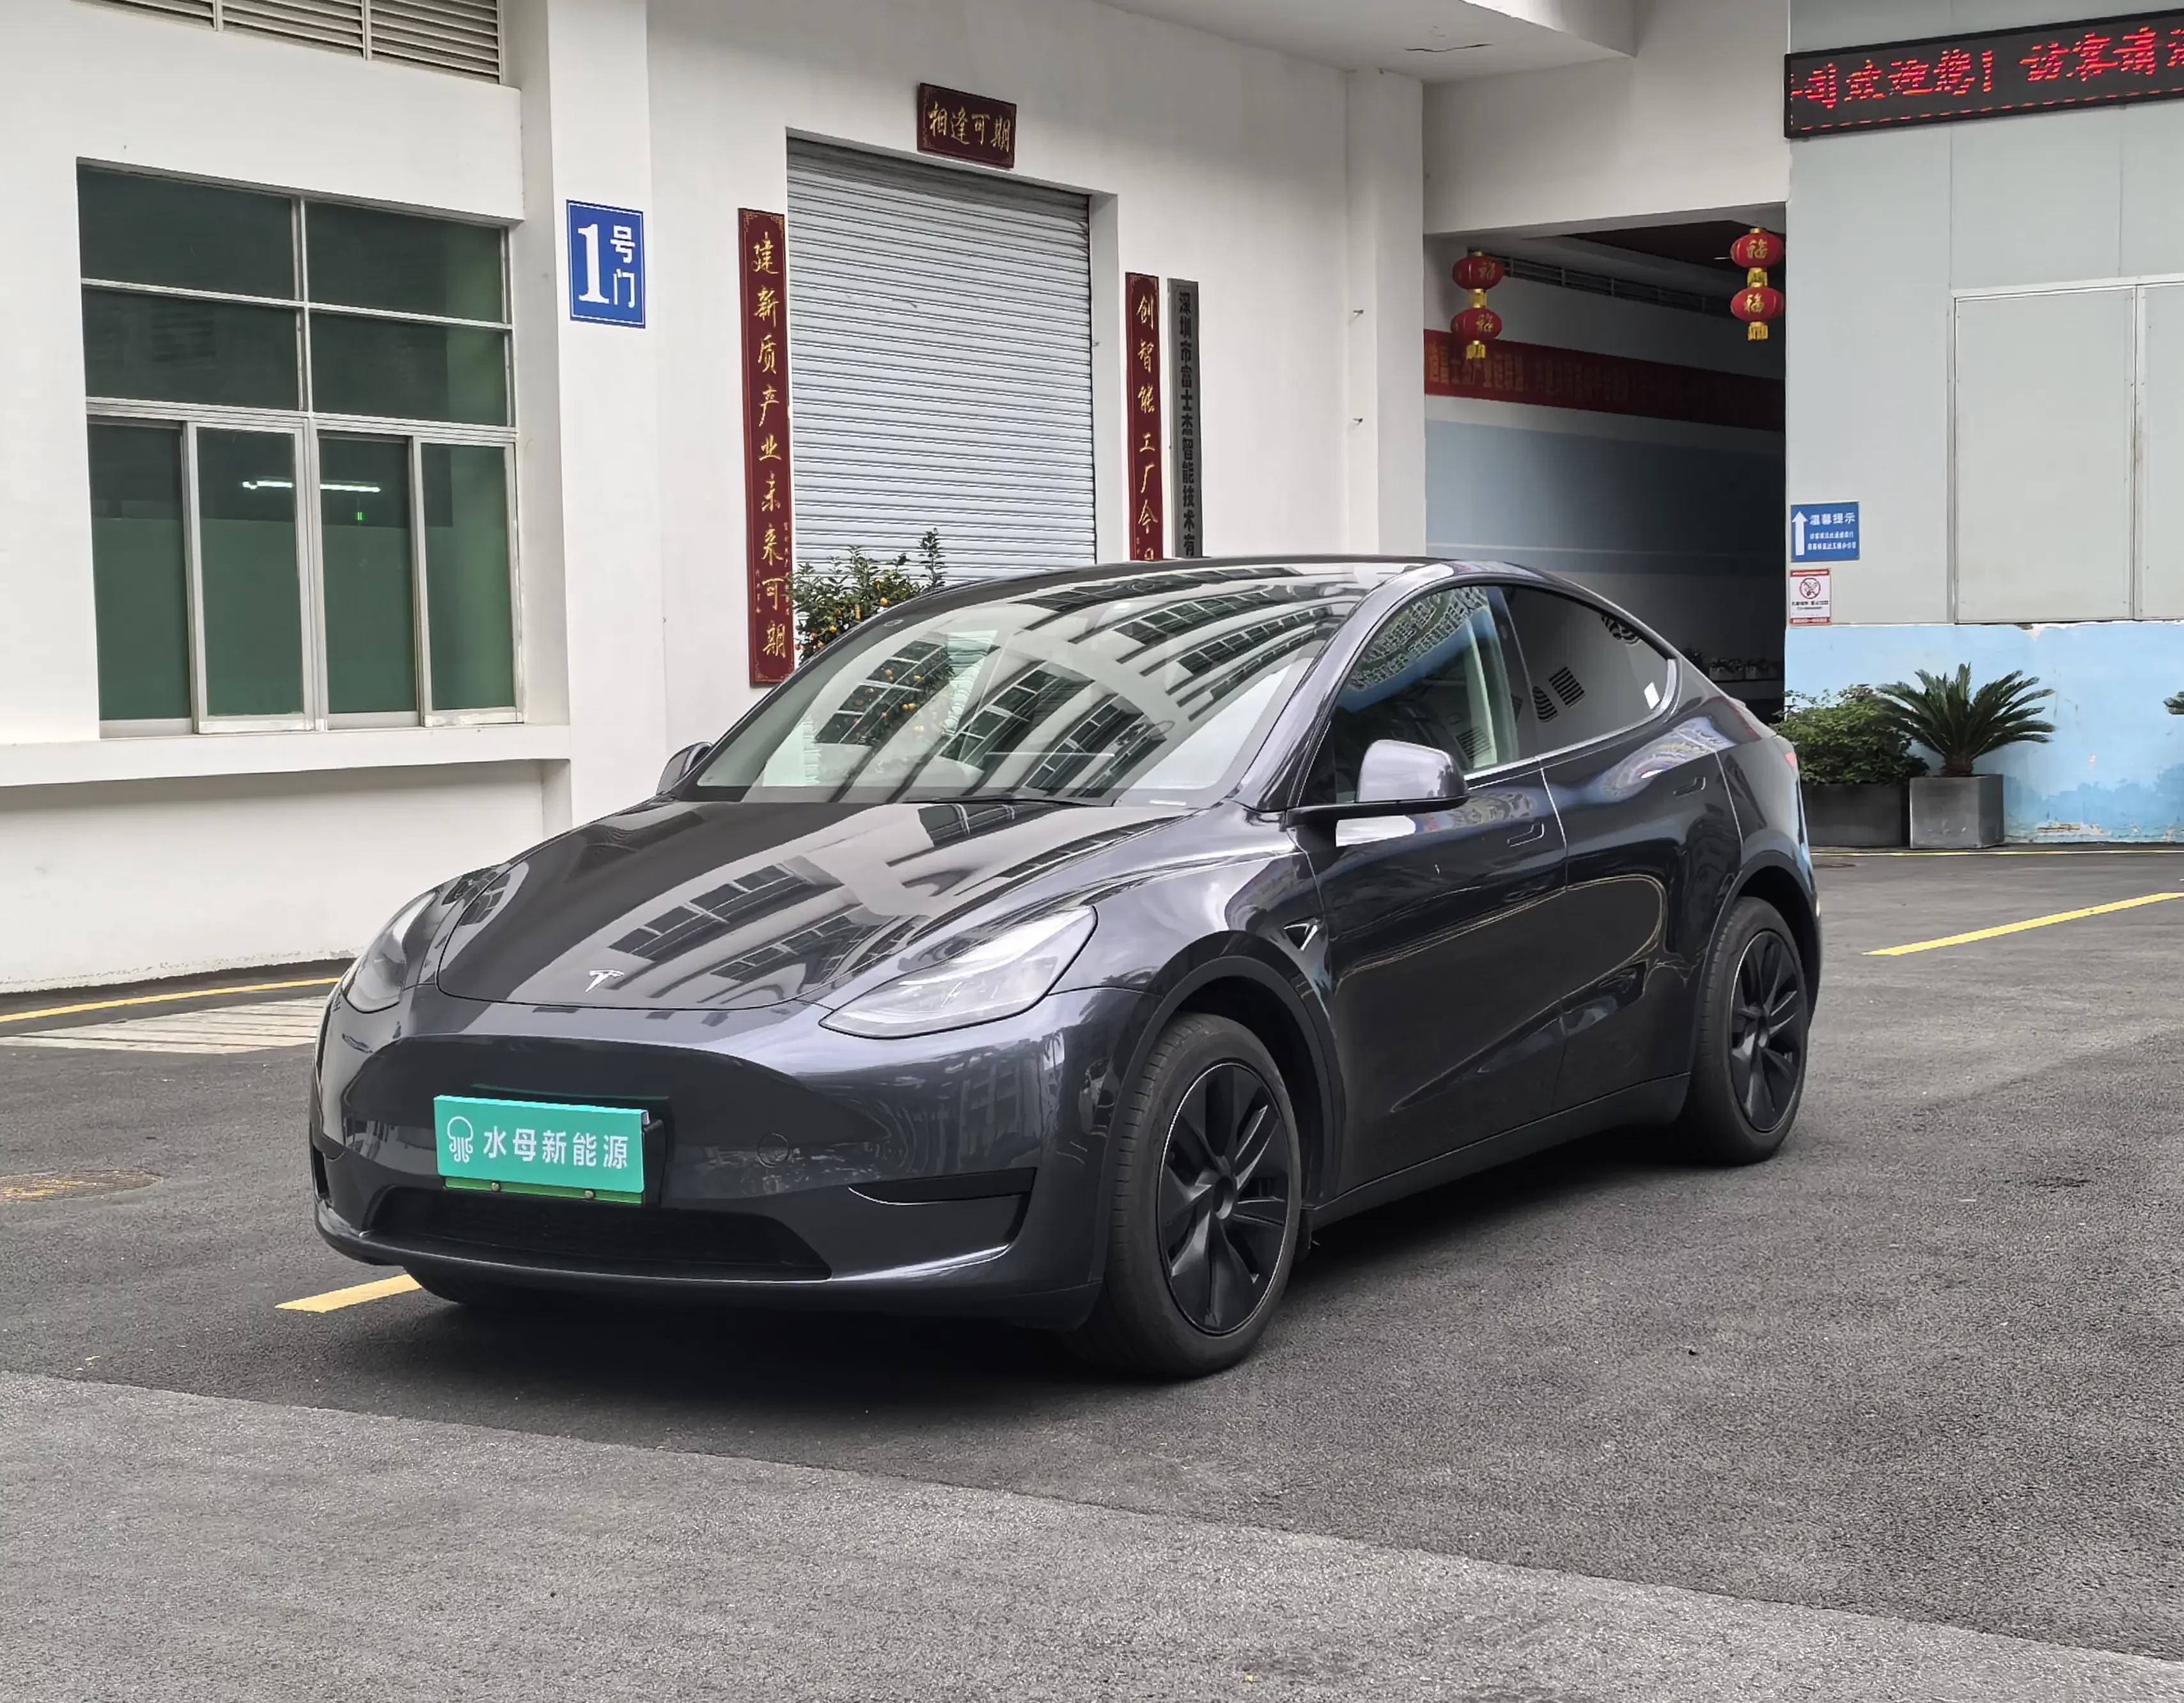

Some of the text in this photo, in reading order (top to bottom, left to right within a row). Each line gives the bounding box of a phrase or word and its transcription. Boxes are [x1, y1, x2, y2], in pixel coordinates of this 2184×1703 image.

[928, 100, 1011, 153] 相逢可期
[577, 223, 636, 308] 1号门
[751, 231, 786, 652] 建新质产业未来可期
[483, 1125, 629, 1169] 水母新能源
